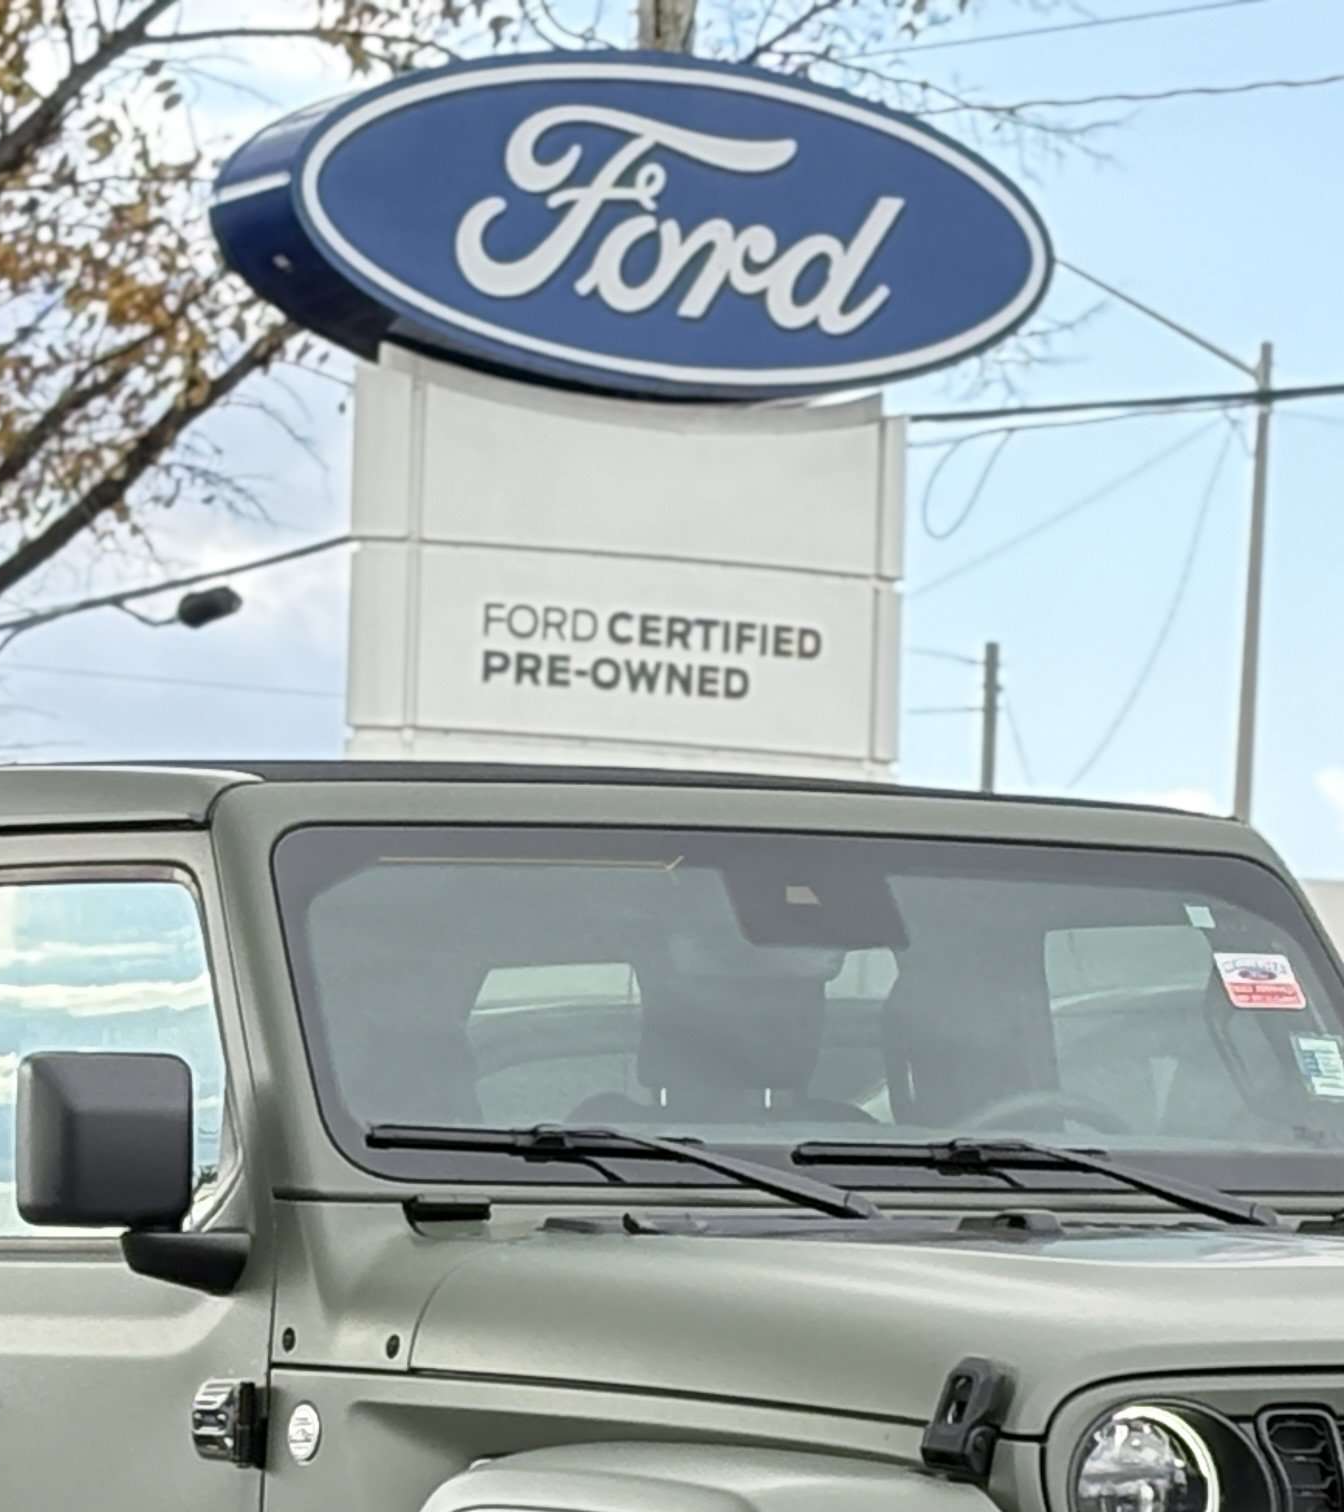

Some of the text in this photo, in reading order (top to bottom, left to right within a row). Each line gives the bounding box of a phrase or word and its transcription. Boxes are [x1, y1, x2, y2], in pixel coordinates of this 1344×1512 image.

[456, 105, 906, 335] Ford
[483, 602, 822, 660] FORD CERTIFIED
[482, 650, 750, 700] PRE-OWNED
